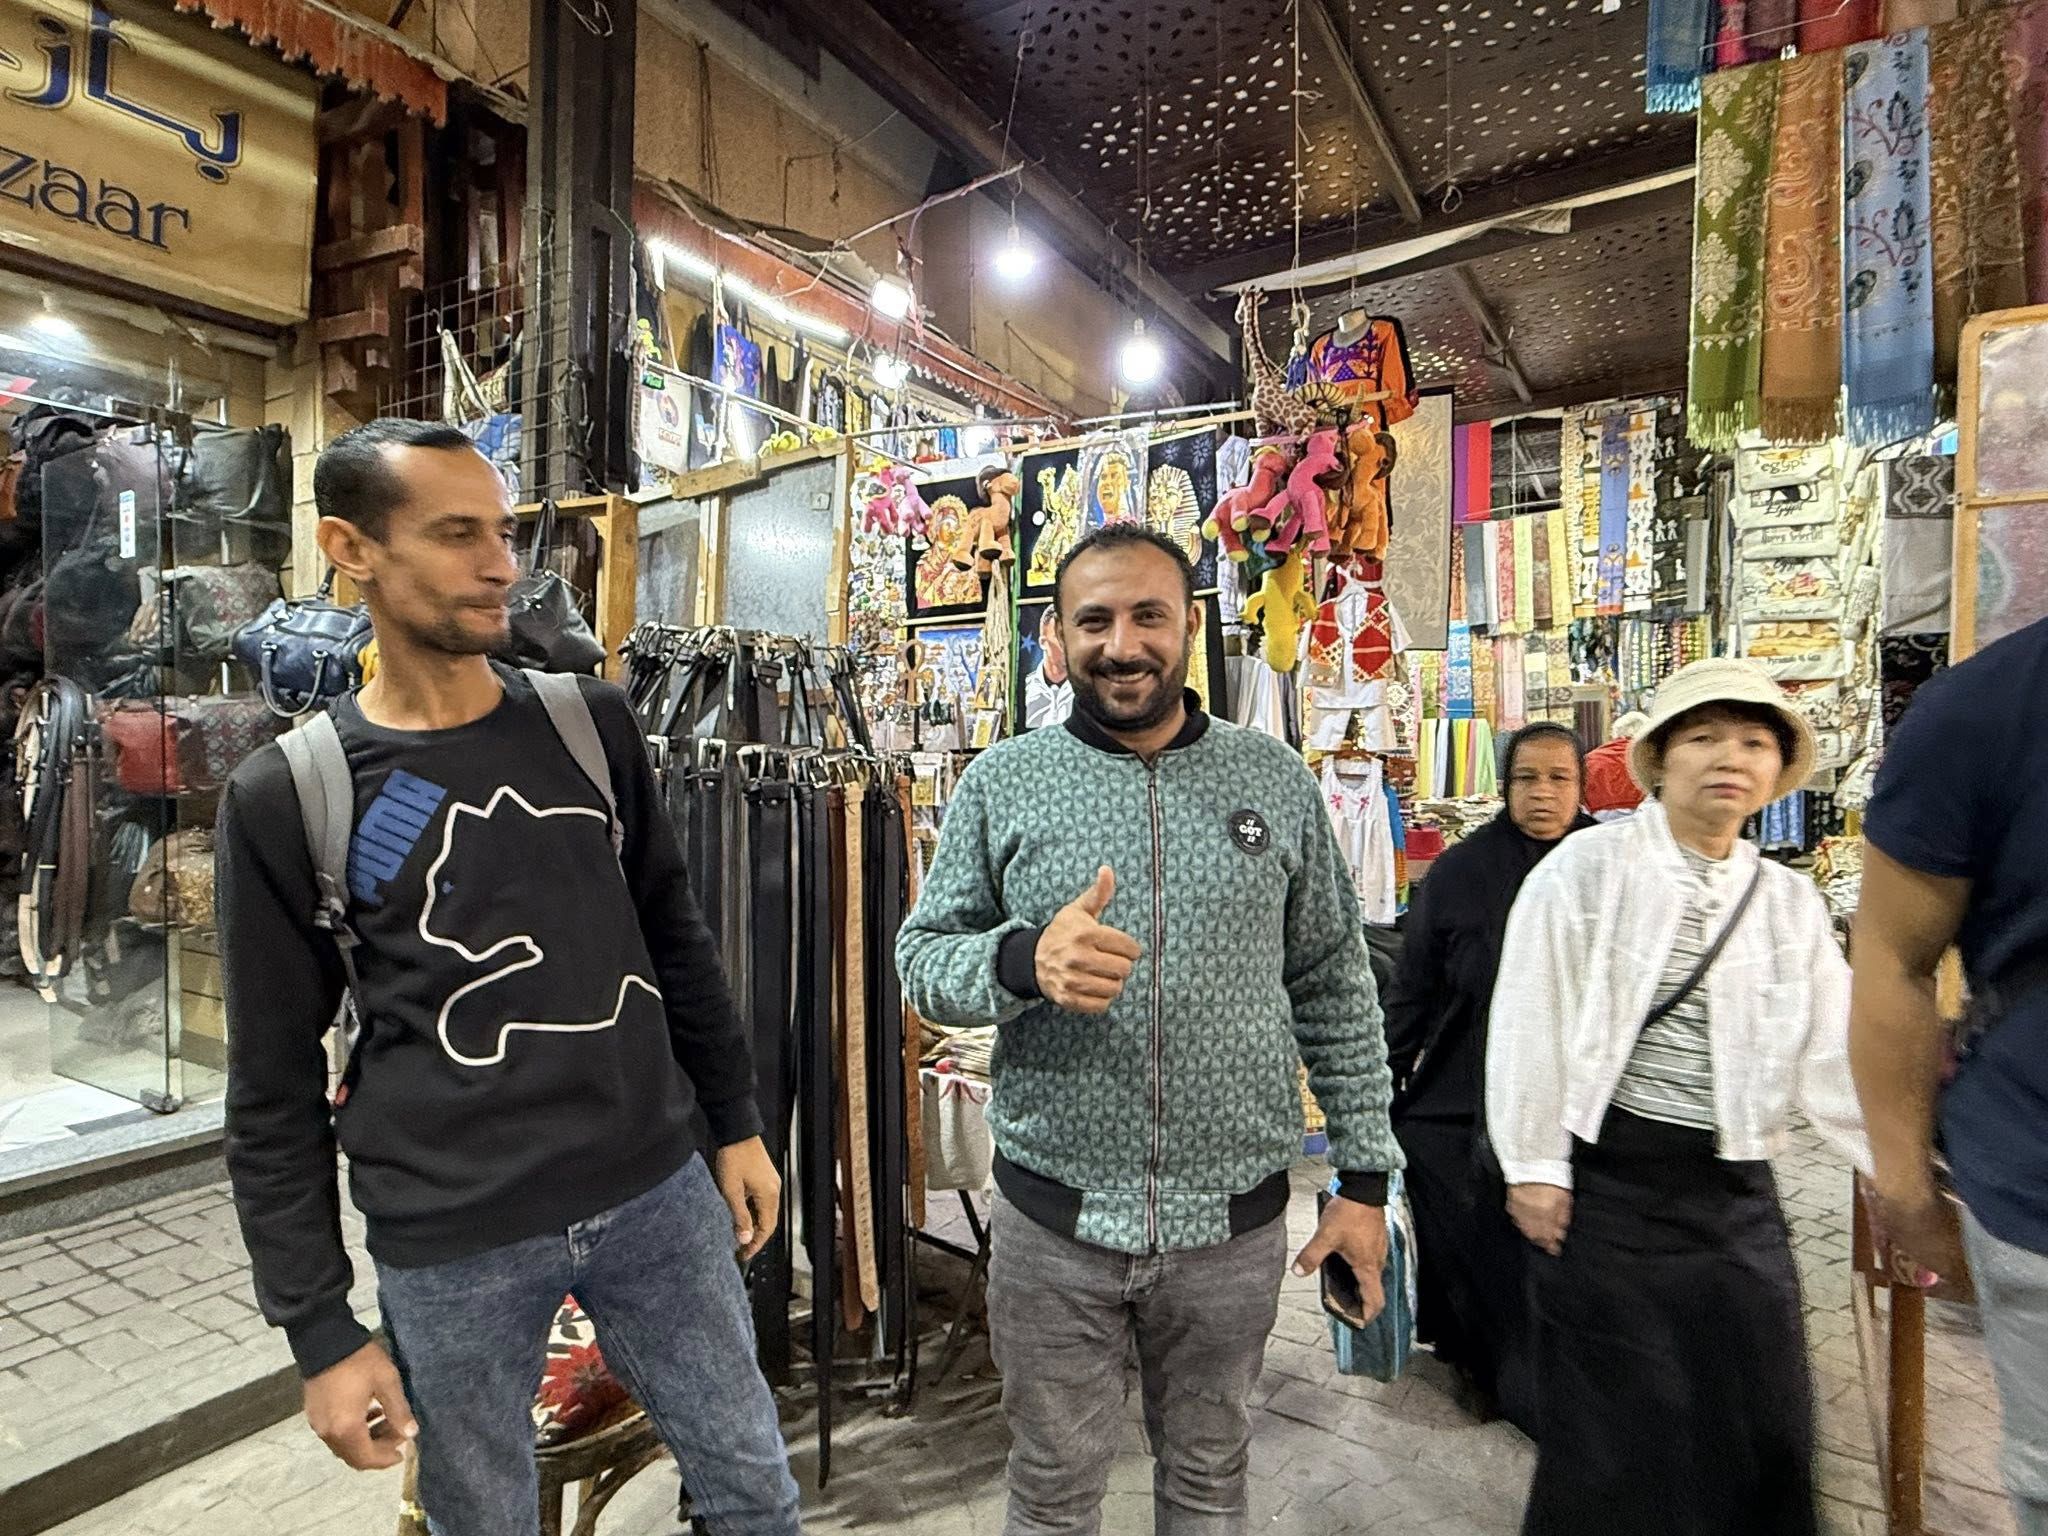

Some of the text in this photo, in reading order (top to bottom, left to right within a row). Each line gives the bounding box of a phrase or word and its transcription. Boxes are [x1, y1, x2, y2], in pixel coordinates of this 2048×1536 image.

[1761, 457, 1808, 474] egypt
[1764, 501, 1804, 517] Egypt
[351, 769, 448, 906] PUMA
[1239, 824, 1262, 837] GOT
